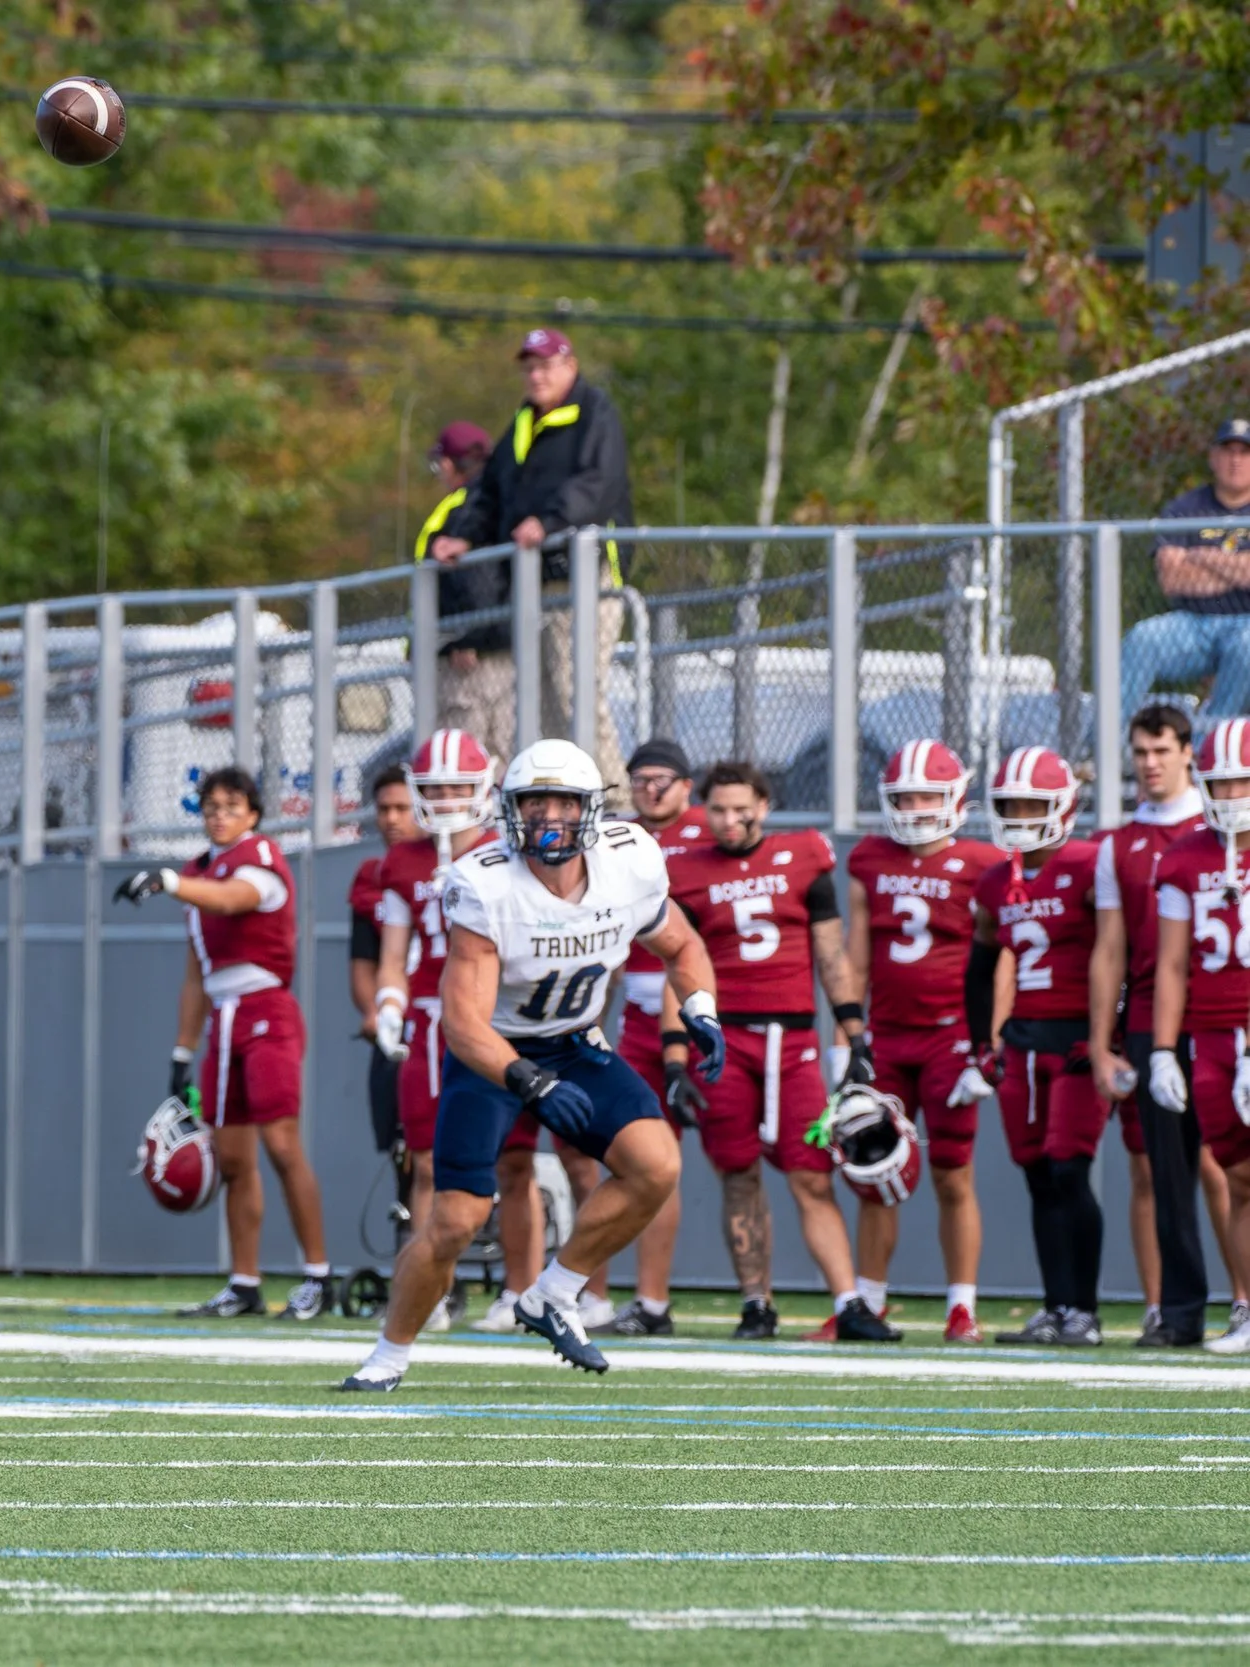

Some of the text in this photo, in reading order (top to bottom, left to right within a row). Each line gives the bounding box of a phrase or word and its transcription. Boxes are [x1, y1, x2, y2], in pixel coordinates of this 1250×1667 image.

[709, 874, 789, 905] BOBCATS
[877, 873, 951, 900] BOBCATS
[530, 923, 625, 958] TRINITY
[732, 897, 781, 962] 5
[888, 894, 933, 964] 3
[1012, 920, 1052, 991] 2
[515, 962, 607, 1020] 10
